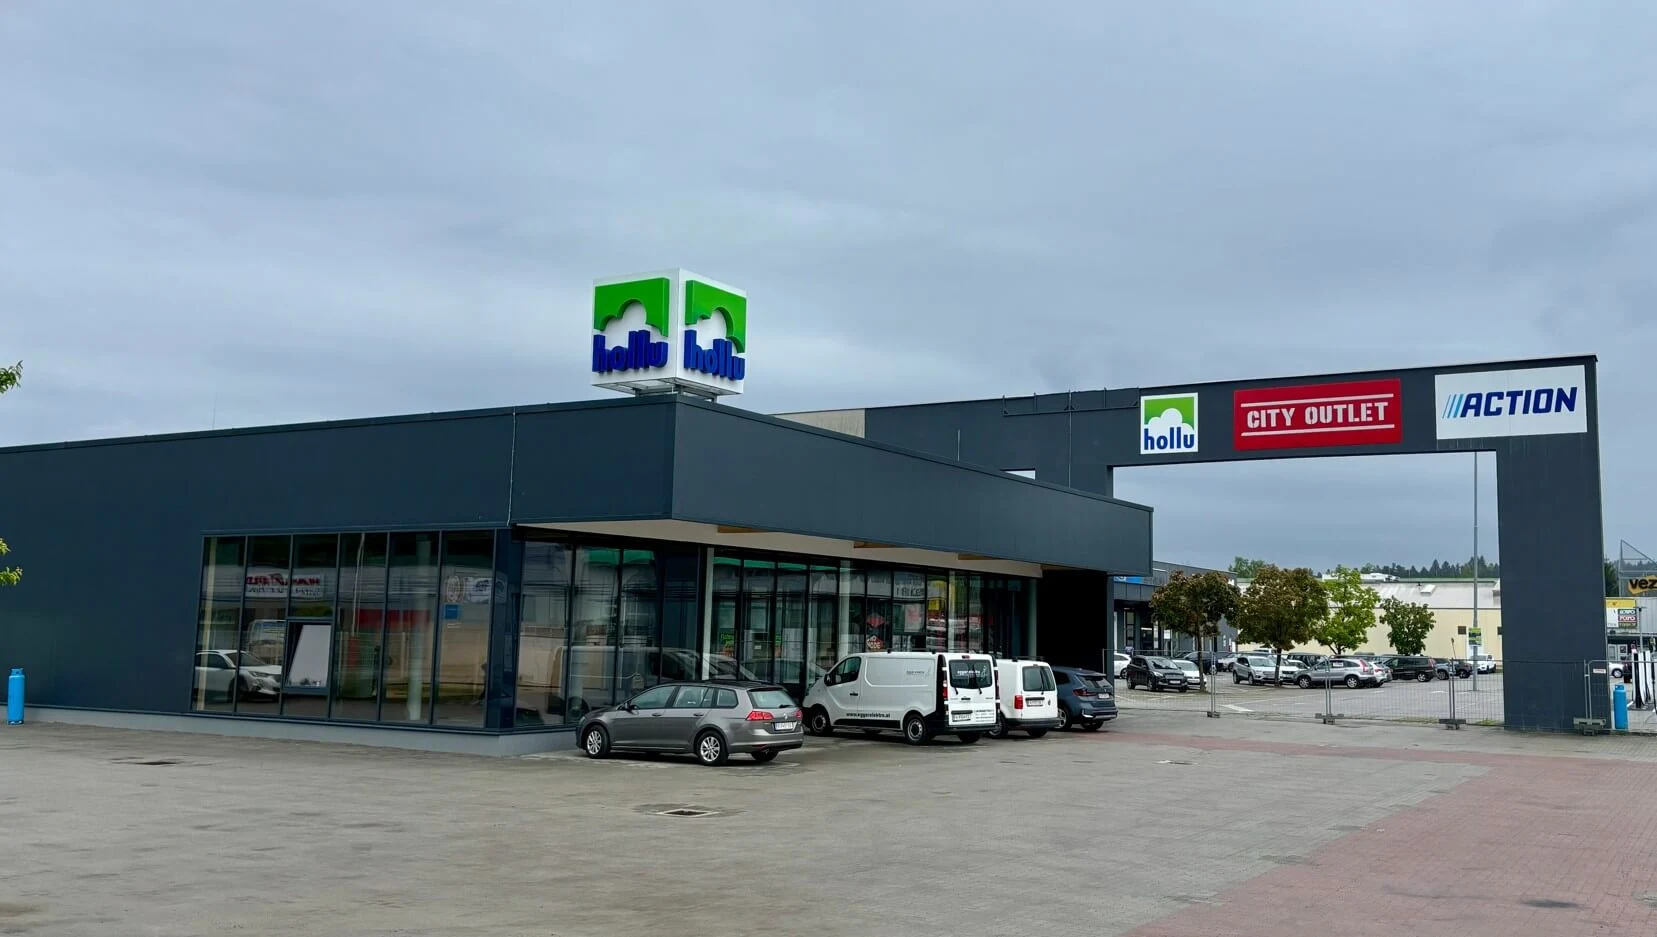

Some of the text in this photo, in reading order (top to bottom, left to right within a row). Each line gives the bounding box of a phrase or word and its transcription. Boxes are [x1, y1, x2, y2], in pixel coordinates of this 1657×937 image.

[592, 330, 669, 373] hollu
[684, 329, 746, 381] hollu
[1247, 401, 1389, 429] CITY OUTLET
[1460, 387, 1578, 418] ACTION
[1143, 426, 1195, 451] hollu
